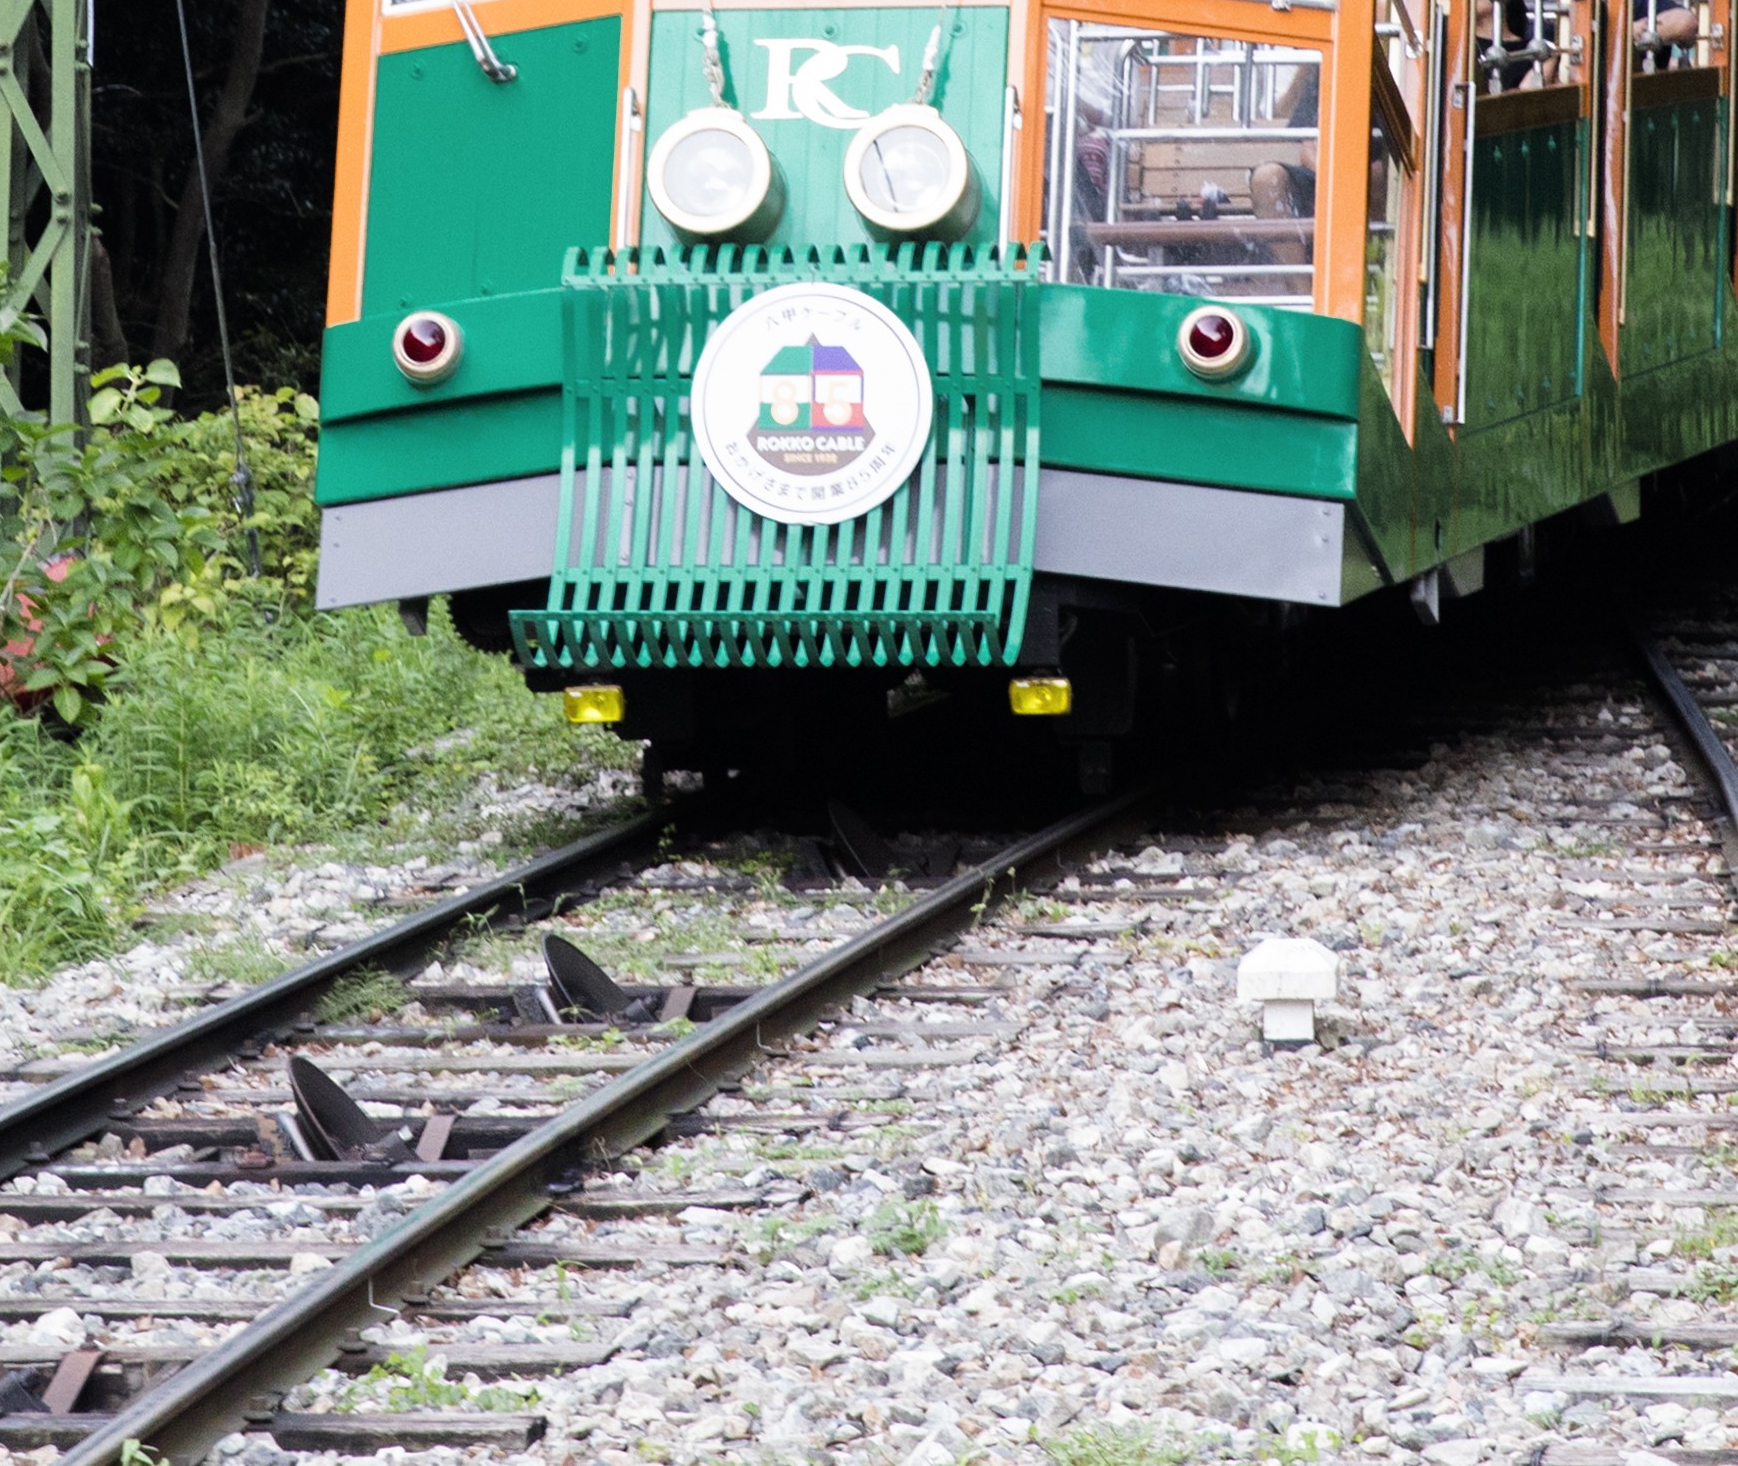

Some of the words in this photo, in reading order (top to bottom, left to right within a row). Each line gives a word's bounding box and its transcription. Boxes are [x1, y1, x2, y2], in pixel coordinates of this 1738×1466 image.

[765, 306, 863, 331] 六甲ケーブル
[770, 379, 852, 426] 85
[757, 436, 815, 452] ROKKO
[815, 436, 865, 452] CABLE
[783, 452, 813, 463] SINCE
